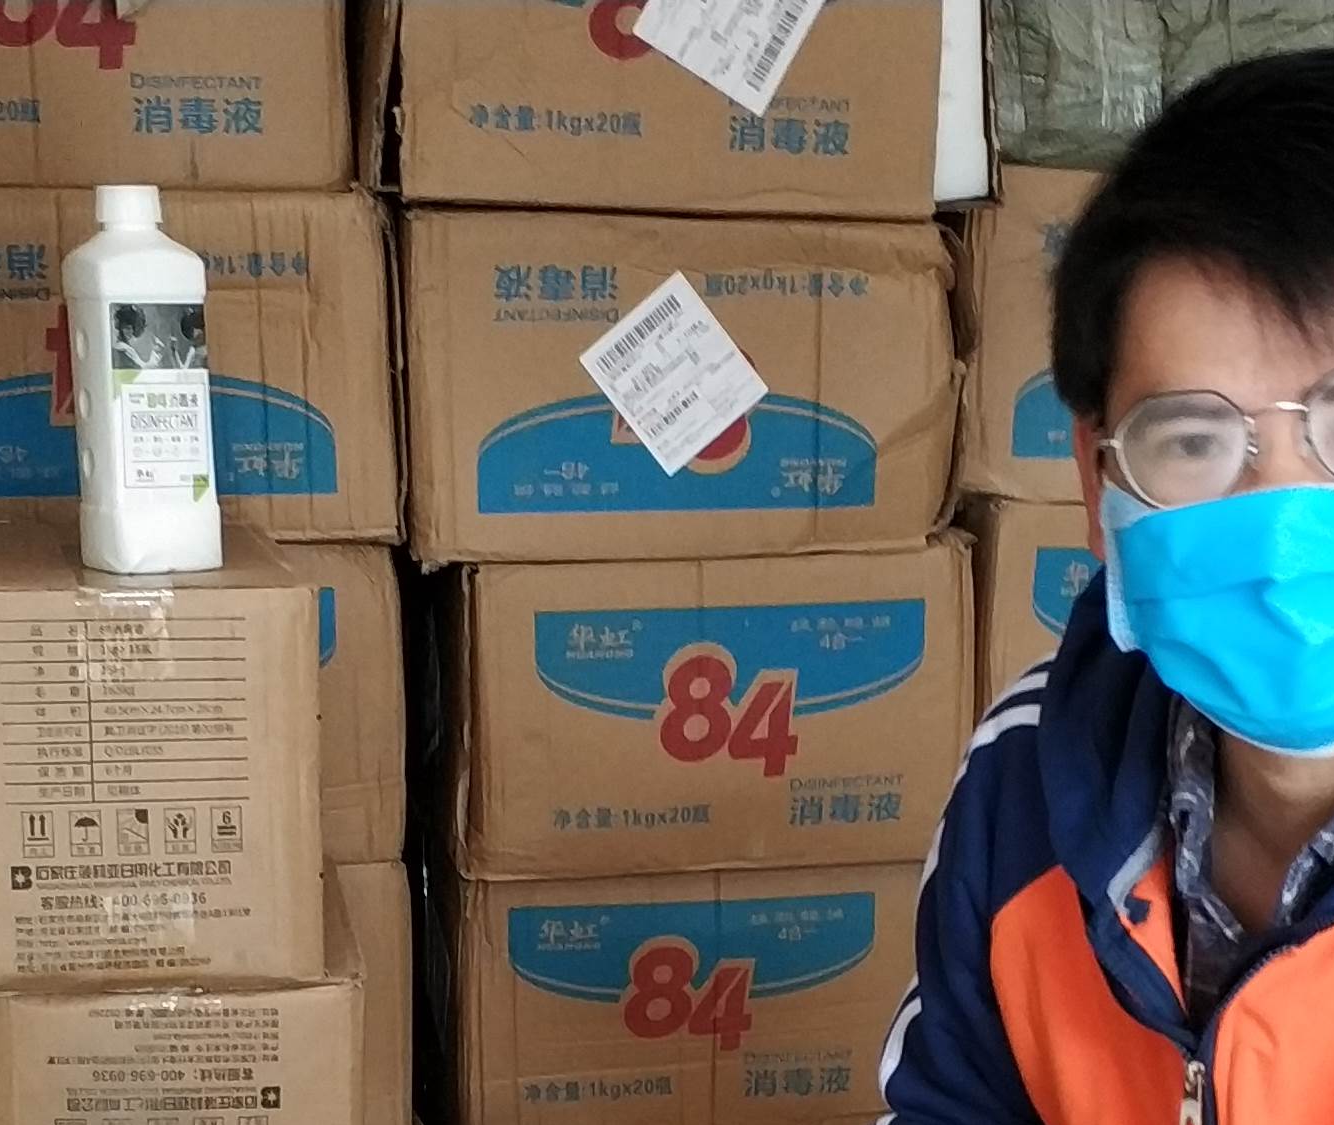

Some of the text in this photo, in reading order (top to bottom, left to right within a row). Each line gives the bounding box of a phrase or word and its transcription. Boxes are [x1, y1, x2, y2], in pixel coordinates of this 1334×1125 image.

[133, 97, 263, 134] 消毒液
[728, 115, 849, 155] 消毒液
[494, 264, 618, 301] 消毒液
[660, 654, 798, 777] 84
[789, 792, 902, 826] 消毒液
[623, 946, 752, 1051] 84
[92, 1069, 186, 1083] 400-696-0936
[743, 1066, 851, 1099] 消毒液
